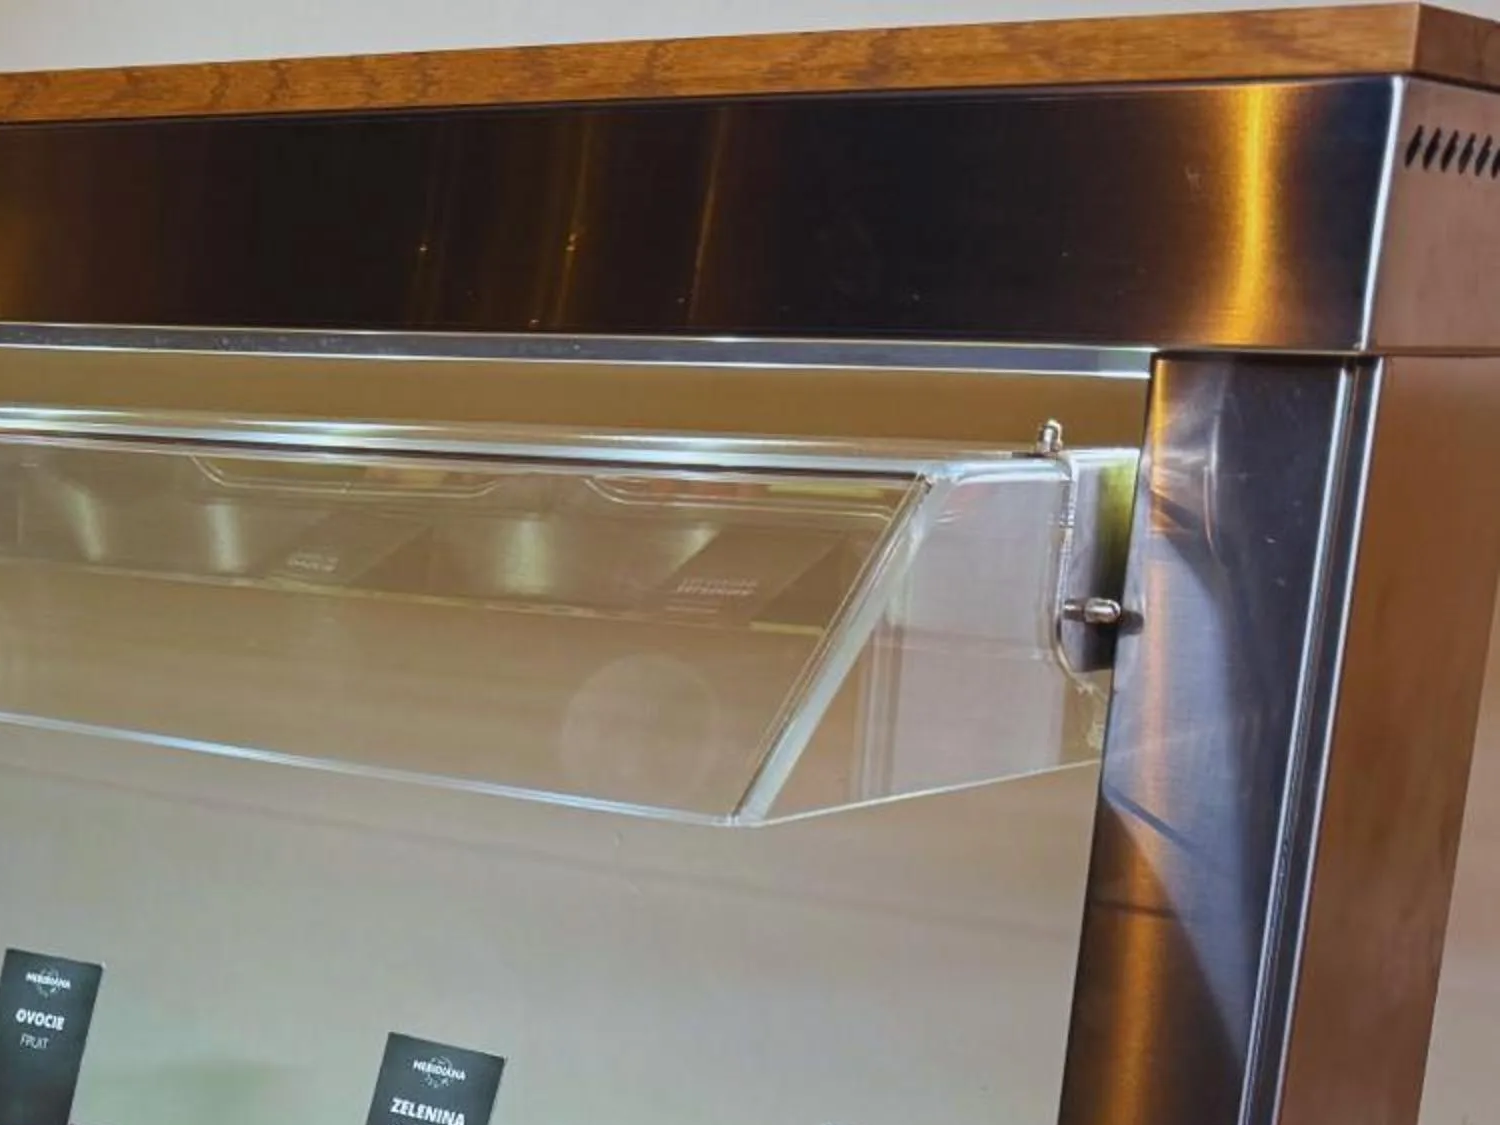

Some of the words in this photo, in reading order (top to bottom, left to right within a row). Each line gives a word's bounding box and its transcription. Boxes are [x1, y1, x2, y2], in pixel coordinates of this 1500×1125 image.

[15, 1008, 65, 1031] OVOCIE
[20, 1033, 49, 1049] FRUIT
[413, 1060, 466, 1081] MERIDIANA
